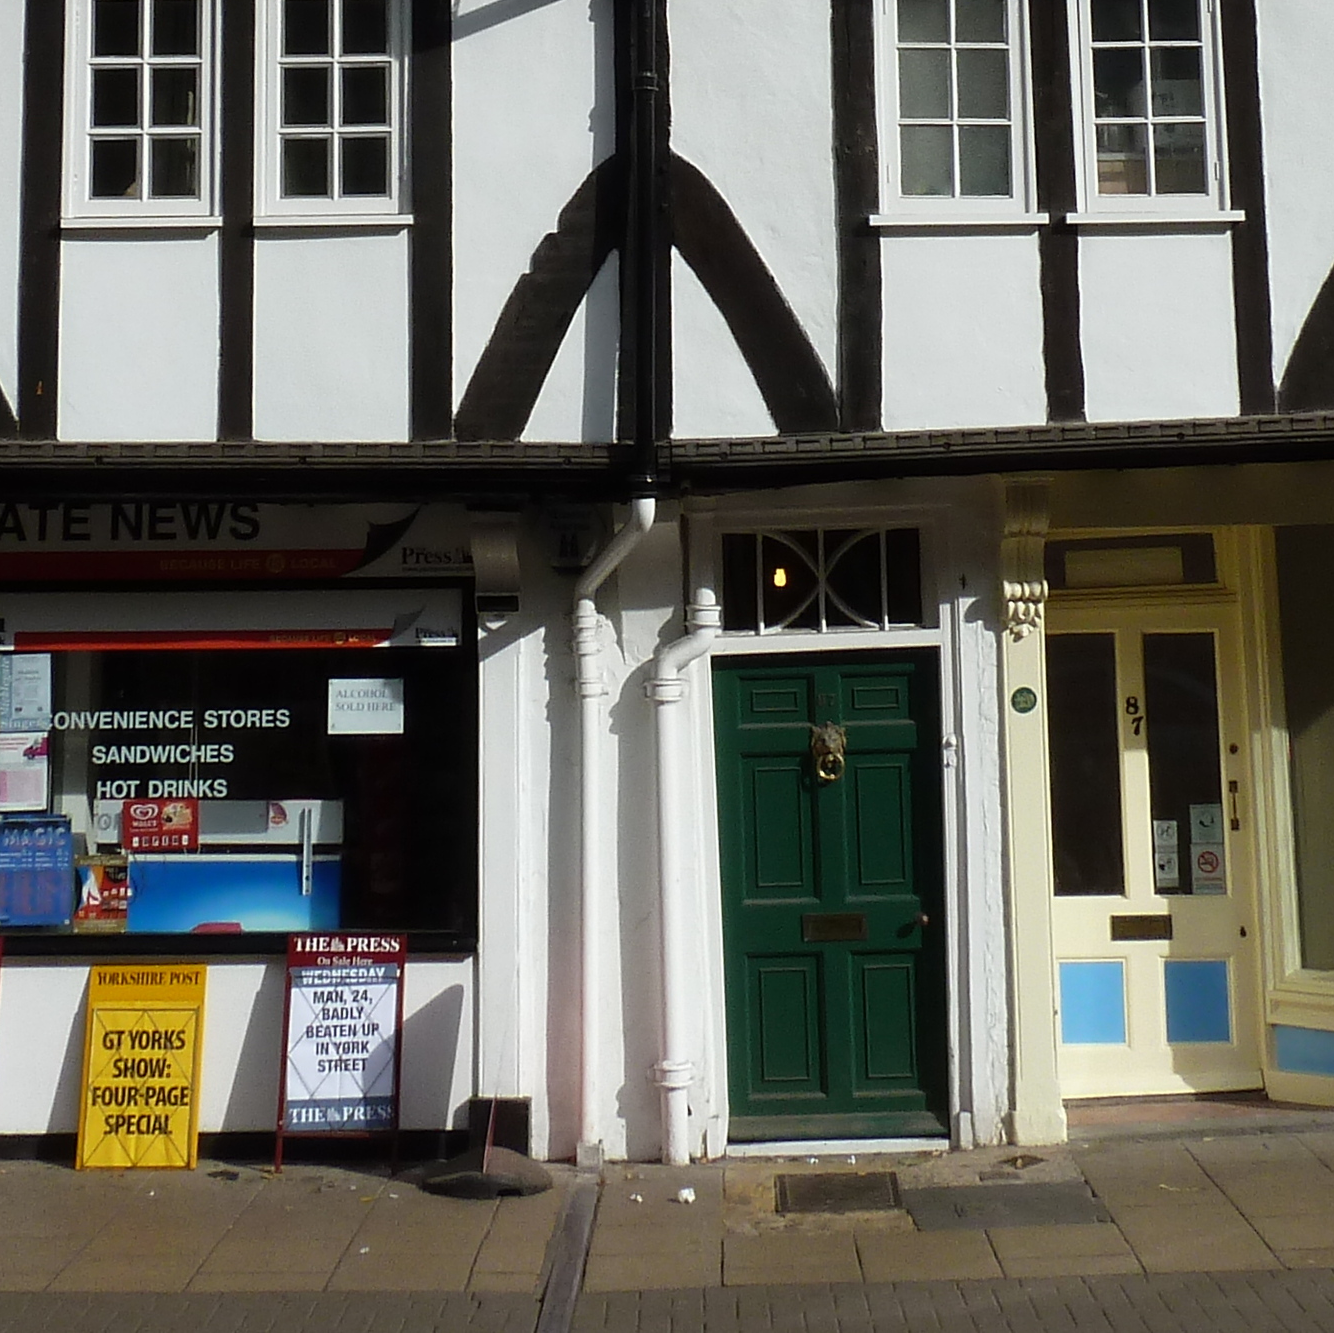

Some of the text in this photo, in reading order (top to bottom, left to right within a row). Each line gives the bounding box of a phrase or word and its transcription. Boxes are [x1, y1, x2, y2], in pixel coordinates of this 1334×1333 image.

[110, 500, 261, 542] NEWS
[402, 546, 452, 565] Press
[335, 689, 388, 699] ALCOHOL
[335, 702, 396, 712] SOLD HERE
[203, 709, 291, 729] STORES
[91, 744, 235, 765] SANDWICHES
[96, 779, 228, 799] HOT DRINKS
[294, 937, 400, 953] THE PRESS
[317, 956, 373, 966] On Sale Here
[97, 971, 201, 986] YORKSHIRE POST
[313, 989, 373, 1006] MAN, 24,
[322, 1006, 364, 1021] BADLY
[306, 1023, 380, 1039] BEATEN UP
[103, 1030, 186, 1051] GT YORKS
[316, 1041, 370, 1056] IN YORK
[112, 1058, 172, 1079] SHOW:
[317, 1057, 367, 1073] STREET
[91, 1086, 190, 1107] FOUR-PAGE
[289, 1107, 327, 1124] THE
[104, 1114, 173, 1135] SPECIAL
